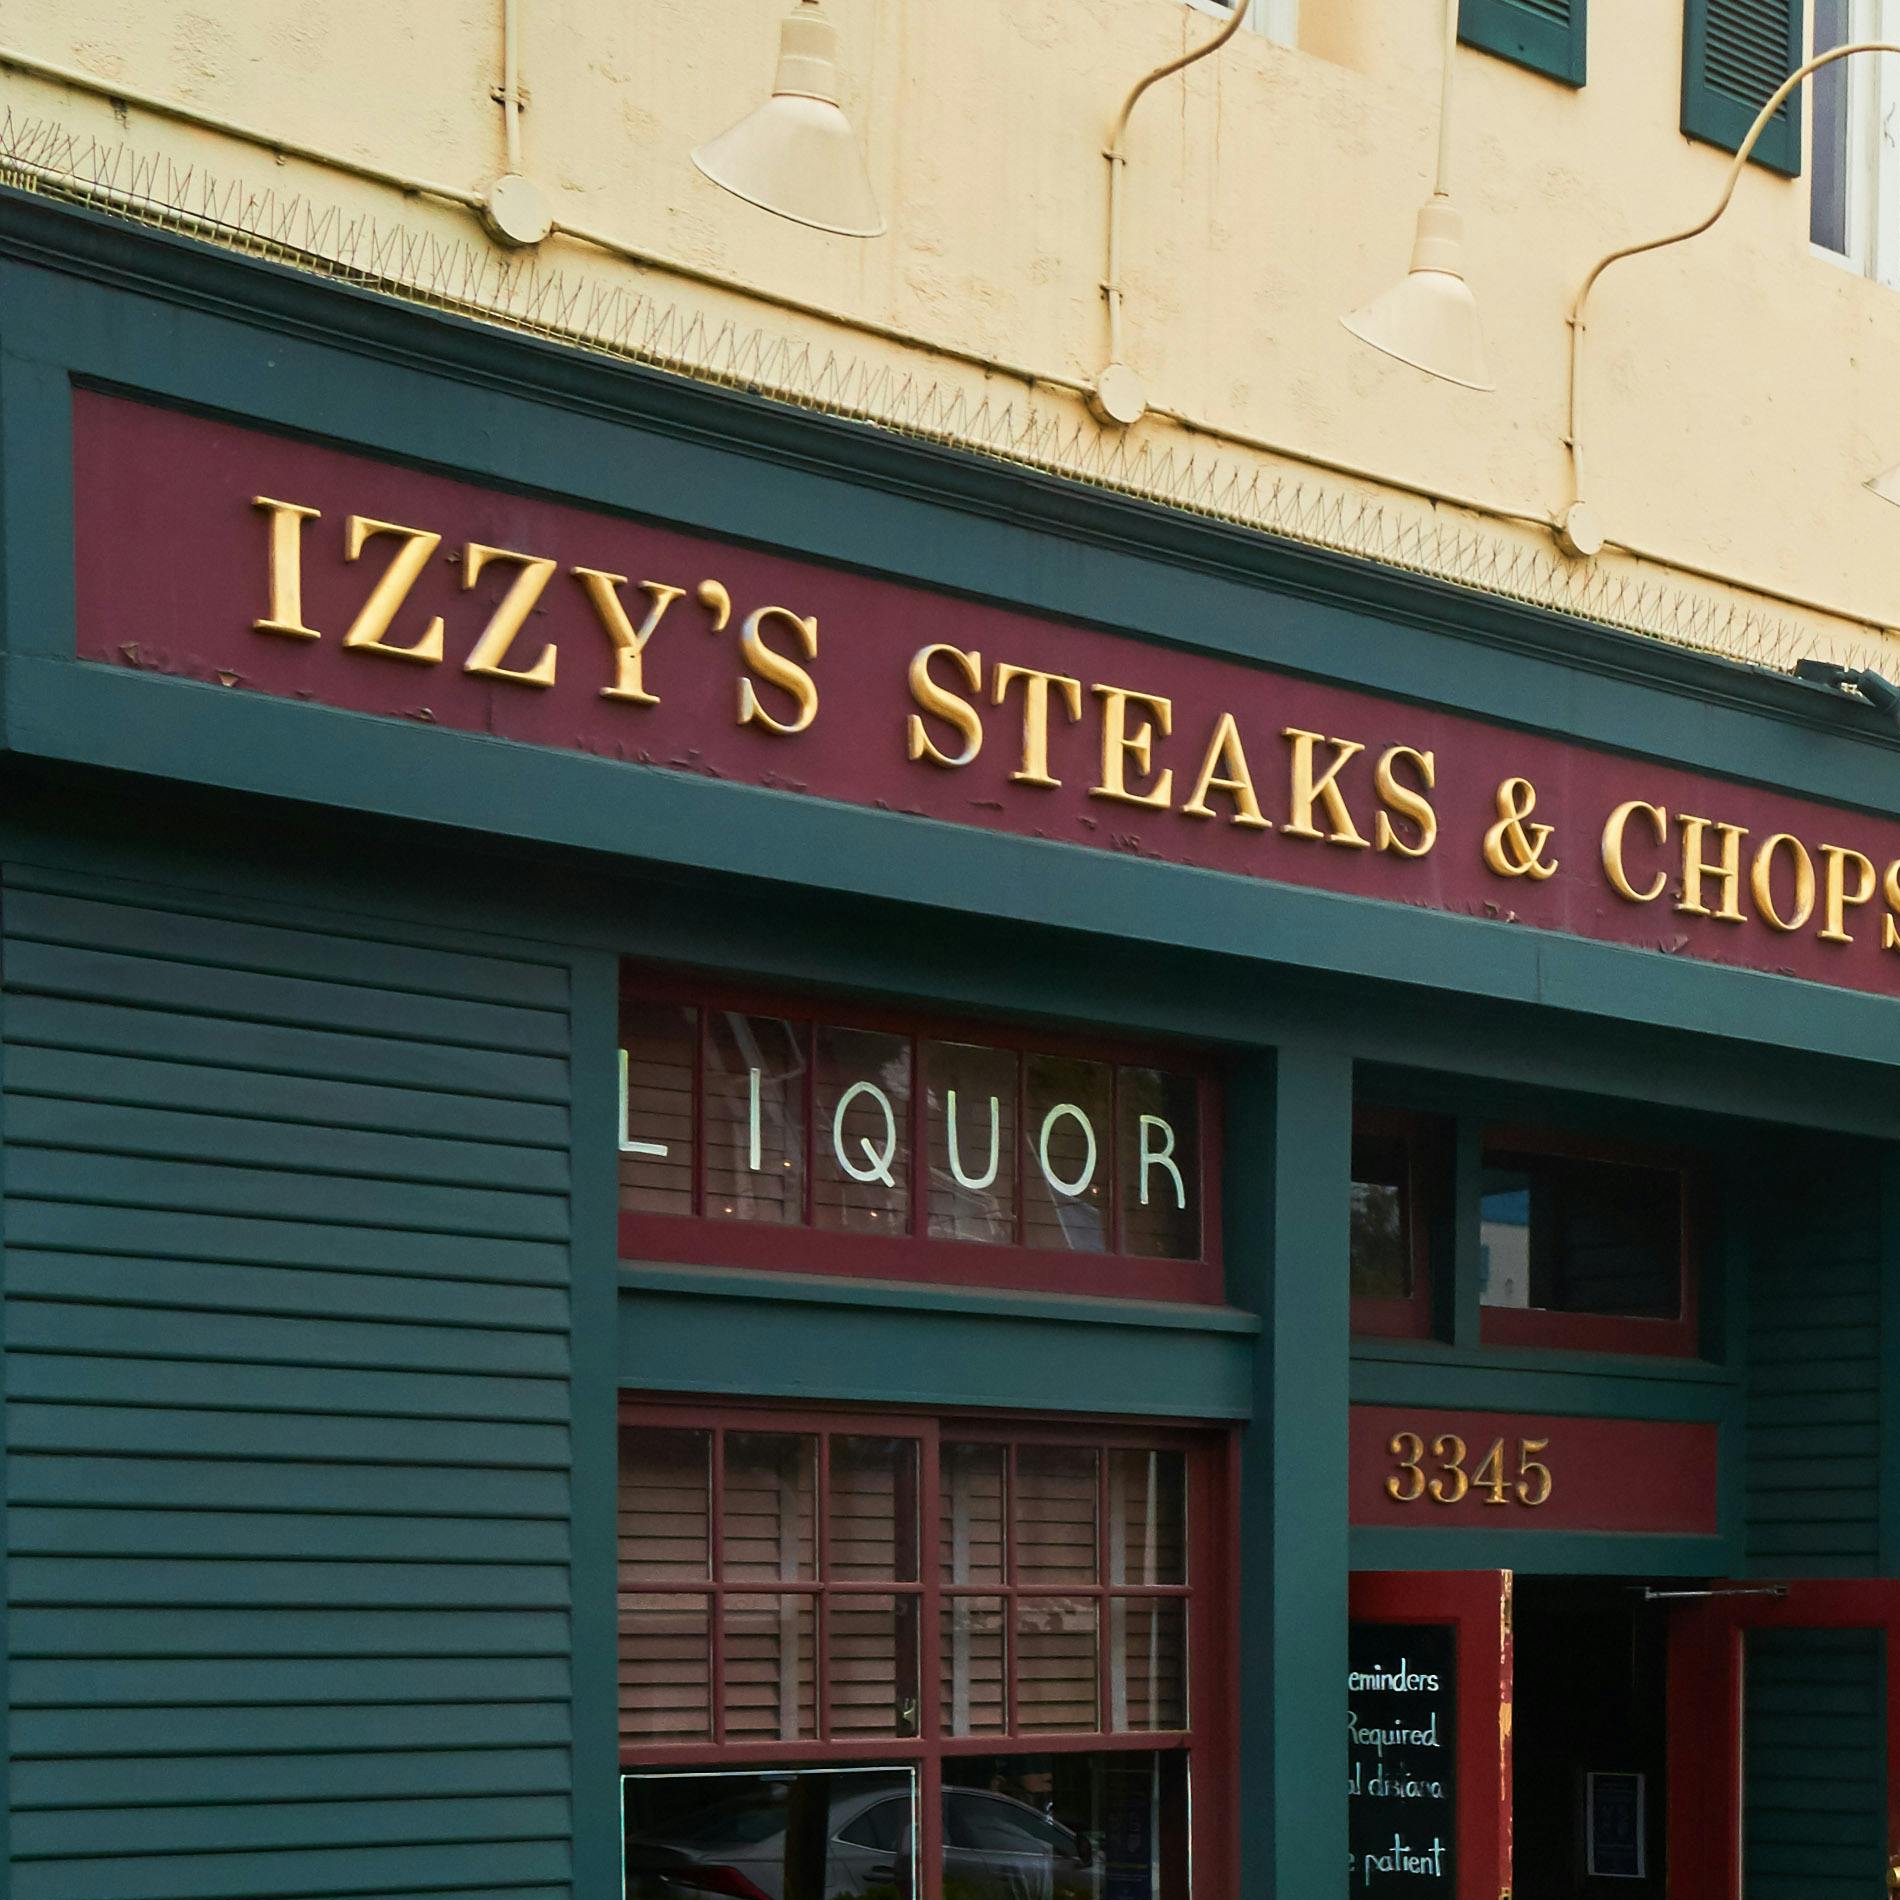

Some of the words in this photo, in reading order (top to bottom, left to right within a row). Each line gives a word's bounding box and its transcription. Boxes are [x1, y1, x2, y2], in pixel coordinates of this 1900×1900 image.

[253, 495, 820, 734] IZZY'S
[906, 643, 1437, 860] STEAKS
[1484, 777, 1559, 879] &
[618, 1049, 1186, 1209] LIQUOR
[1386, 1431, 1553, 1506] 3345
[1348, 1657, 1440, 1691] eminders
[1364, 1833, 1446, 1887] patient
